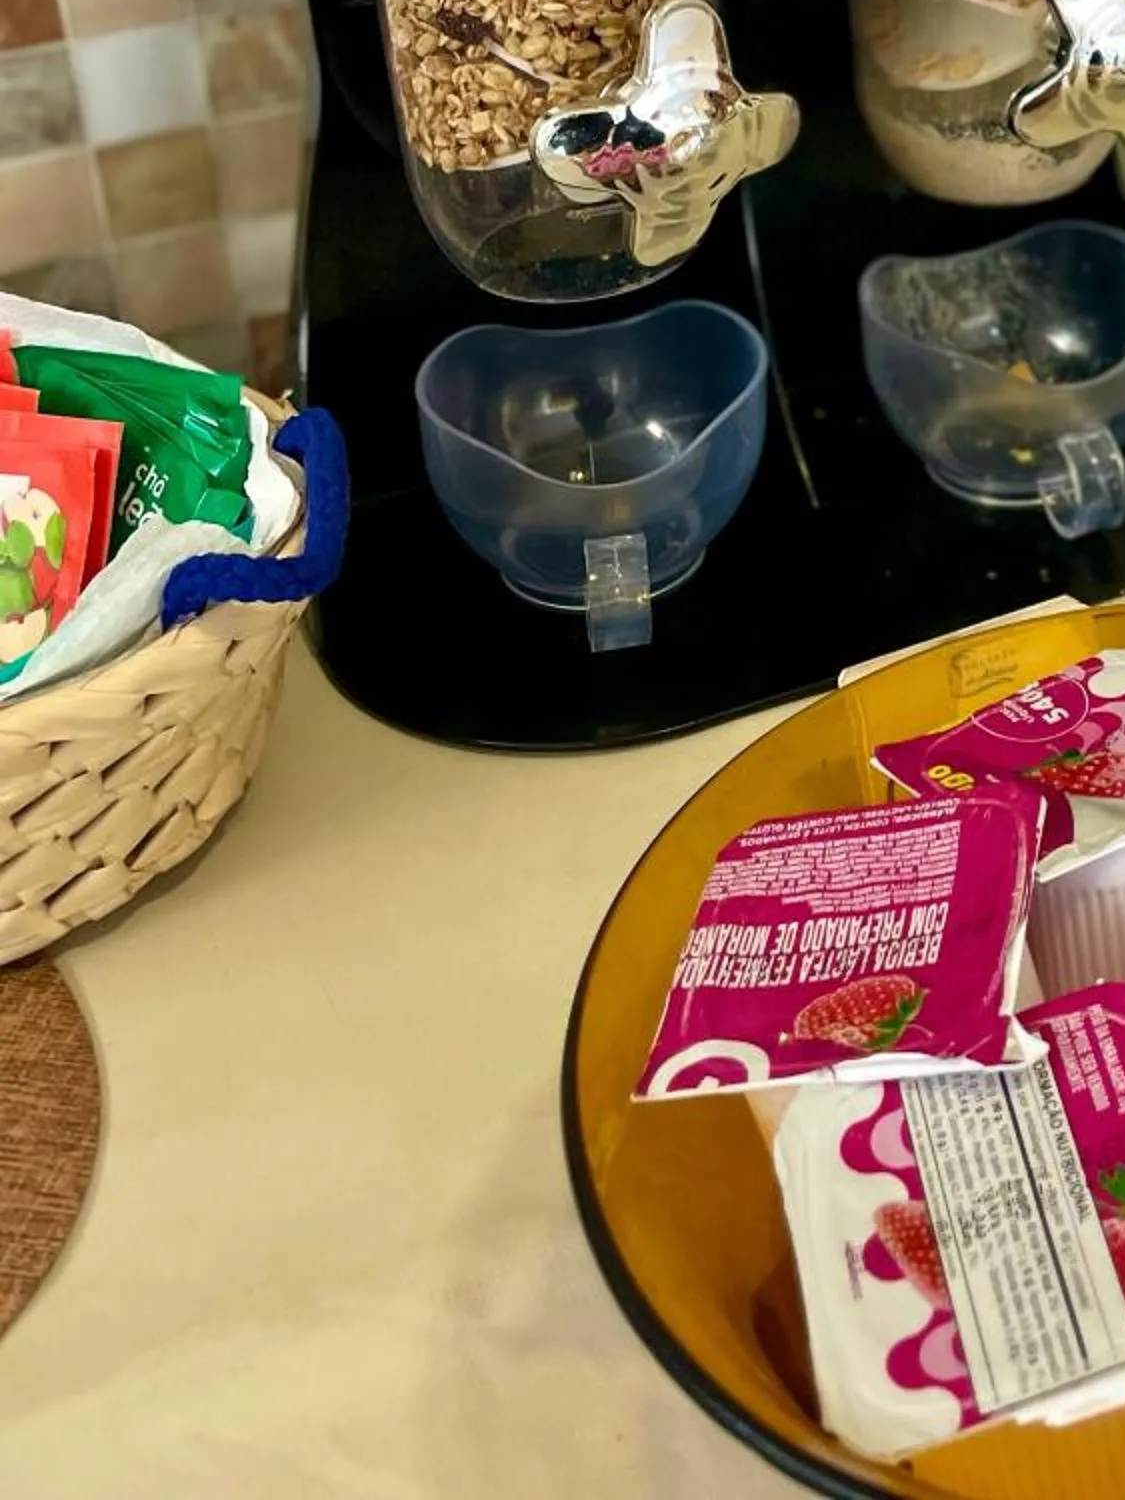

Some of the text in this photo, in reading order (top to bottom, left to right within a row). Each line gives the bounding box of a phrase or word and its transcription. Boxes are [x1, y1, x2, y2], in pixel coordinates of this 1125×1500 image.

[771, 921, 800, 955] DE
[799, 907, 907, 952] PREPARADO
[908, 901, 949, 936] COM
[798, 943, 873, 982] LÁCTEA
[873, 931, 943, 973] BEBIDA
[1033, 1060, 1063, 1134] ORMAÇÃO
